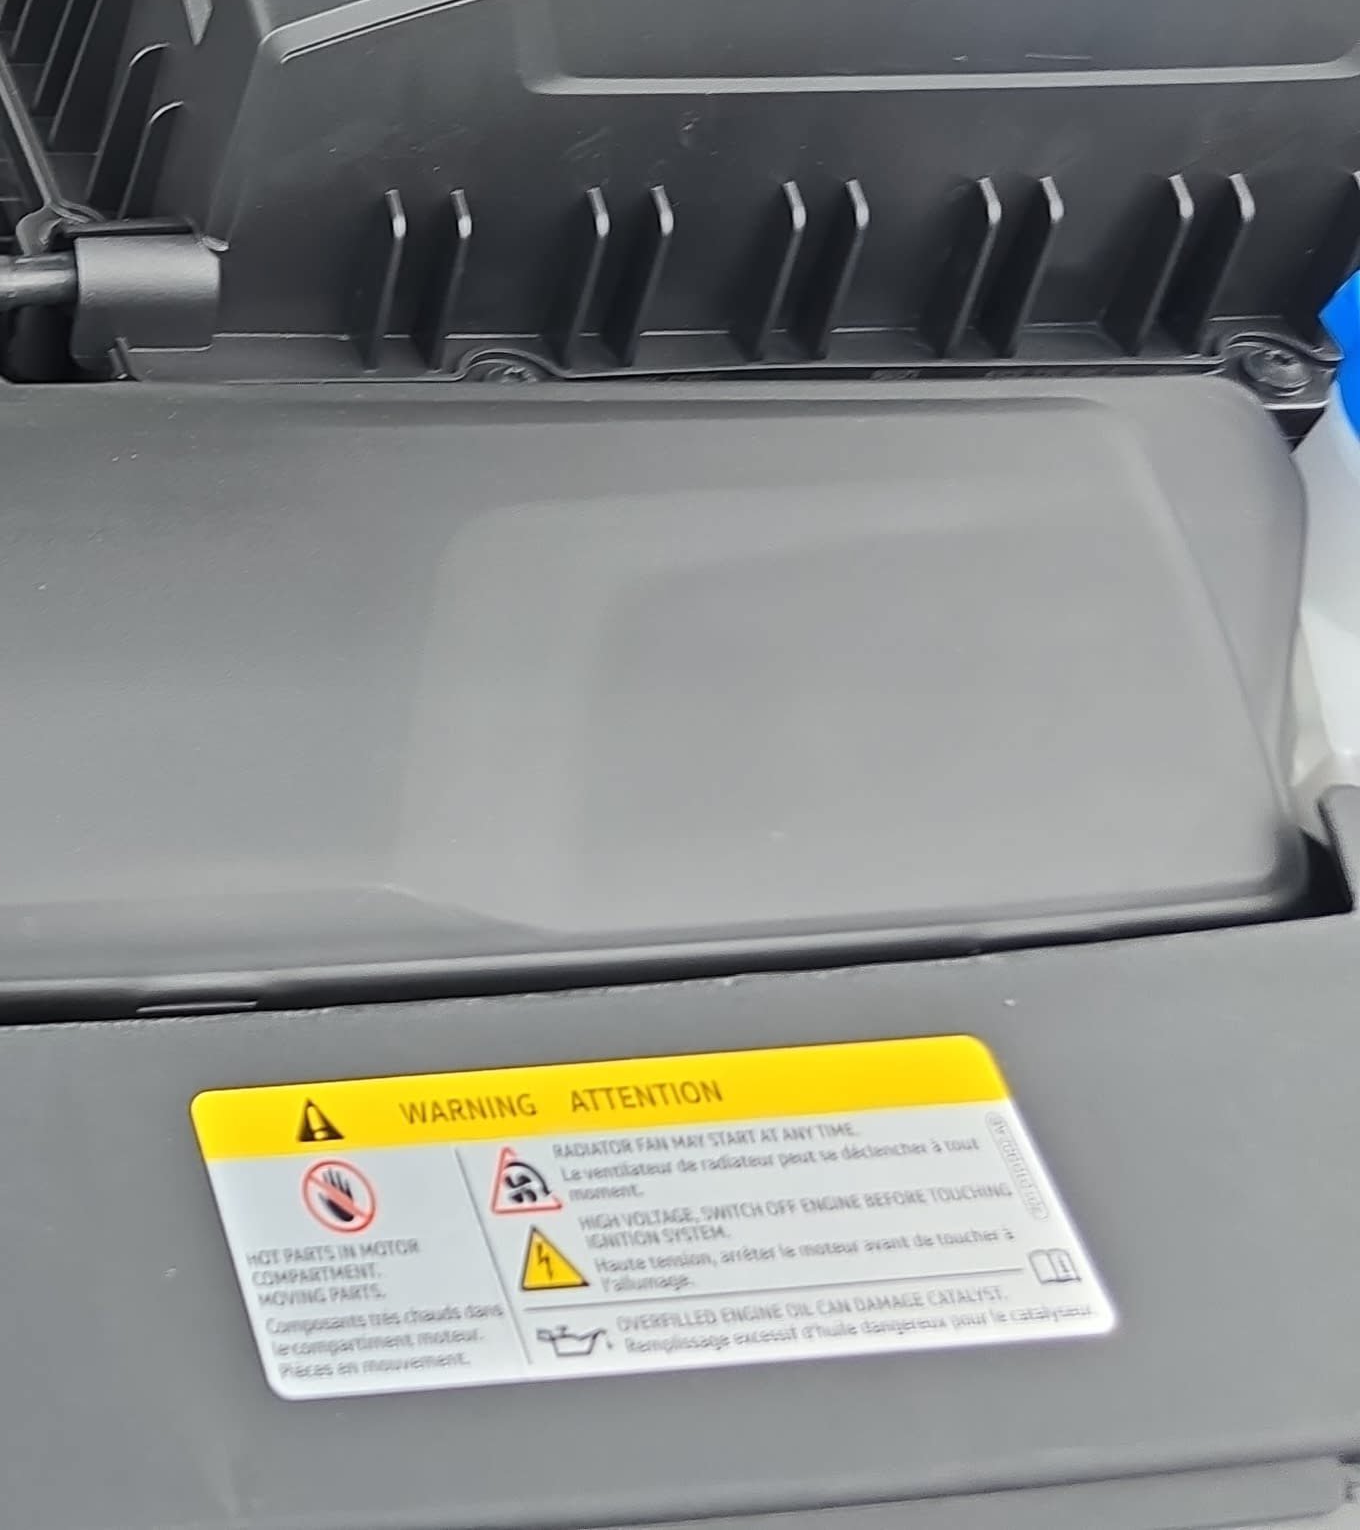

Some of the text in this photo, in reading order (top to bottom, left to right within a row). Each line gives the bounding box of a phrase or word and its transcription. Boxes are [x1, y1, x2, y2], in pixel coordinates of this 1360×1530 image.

[399, 1080, 723, 1125] WARNING ATTENTION
[552, 1122, 859, 1159] RADIATOR FAN MAY START AT ANY TIME.
[561, 1137, 979, 1182] Le ventilateur de radiateur peut se déclencher à tout
[569, 1184, 644, 1202] moment.
[579, 1214, 625, 1231] HIGH
[700, 1202, 765, 1223] SWITCH
[766, 1200, 797, 1217] OFF
[801, 1195, 861, 1213] ENGINE
[865, 1189, 927, 1208] BEFORE
[930, 1183, 1013, 1202] TOUCHING
[245, 1239, 421, 1267] HOT PARTS IN MOTOR
[586, 1225, 728, 1250] IGNITION SYSTEM.
[596, 1254, 644, 1273] Haute
[649, 1250, 714, 1271] tension,
[720, 1246, 776, 1264] arrêter
[780, 1244, 795, 1259] le
[800, 1240, 859, 1257] moteur
[864, 1236, 907, 1252] avant
[914, 1234, 934, 1248] de
[937, 1229, 1001, 1245] toucher
[250, 1262, 382, 1286] COMPARTMENT.
[258, 1284, 387, 1306] MOVING PARTS.
[617, 1285, 1009, 1333] OVERFILLED ENGINE OIL CAN DAMAGE CATALYST.
[265, 1313, 366, 1335] Composants
[404, 1305, 461, 1324] chauds
[464, 1302, 505, 1319] dans
[624, 1332, 730, 1354] Remplissage
[734, 1327, 799, 1347] excessif
[801, 1322, 858, 1341] d'huile
[861, 1317, 947, 1339] dangereux
[951, 1313, 988, 1332] pour
[991, 1309, 1008, 1325] le
[271, 1327, 485, 1356] le compartiment moteur.
[337, 1361, 360, 1375] en
